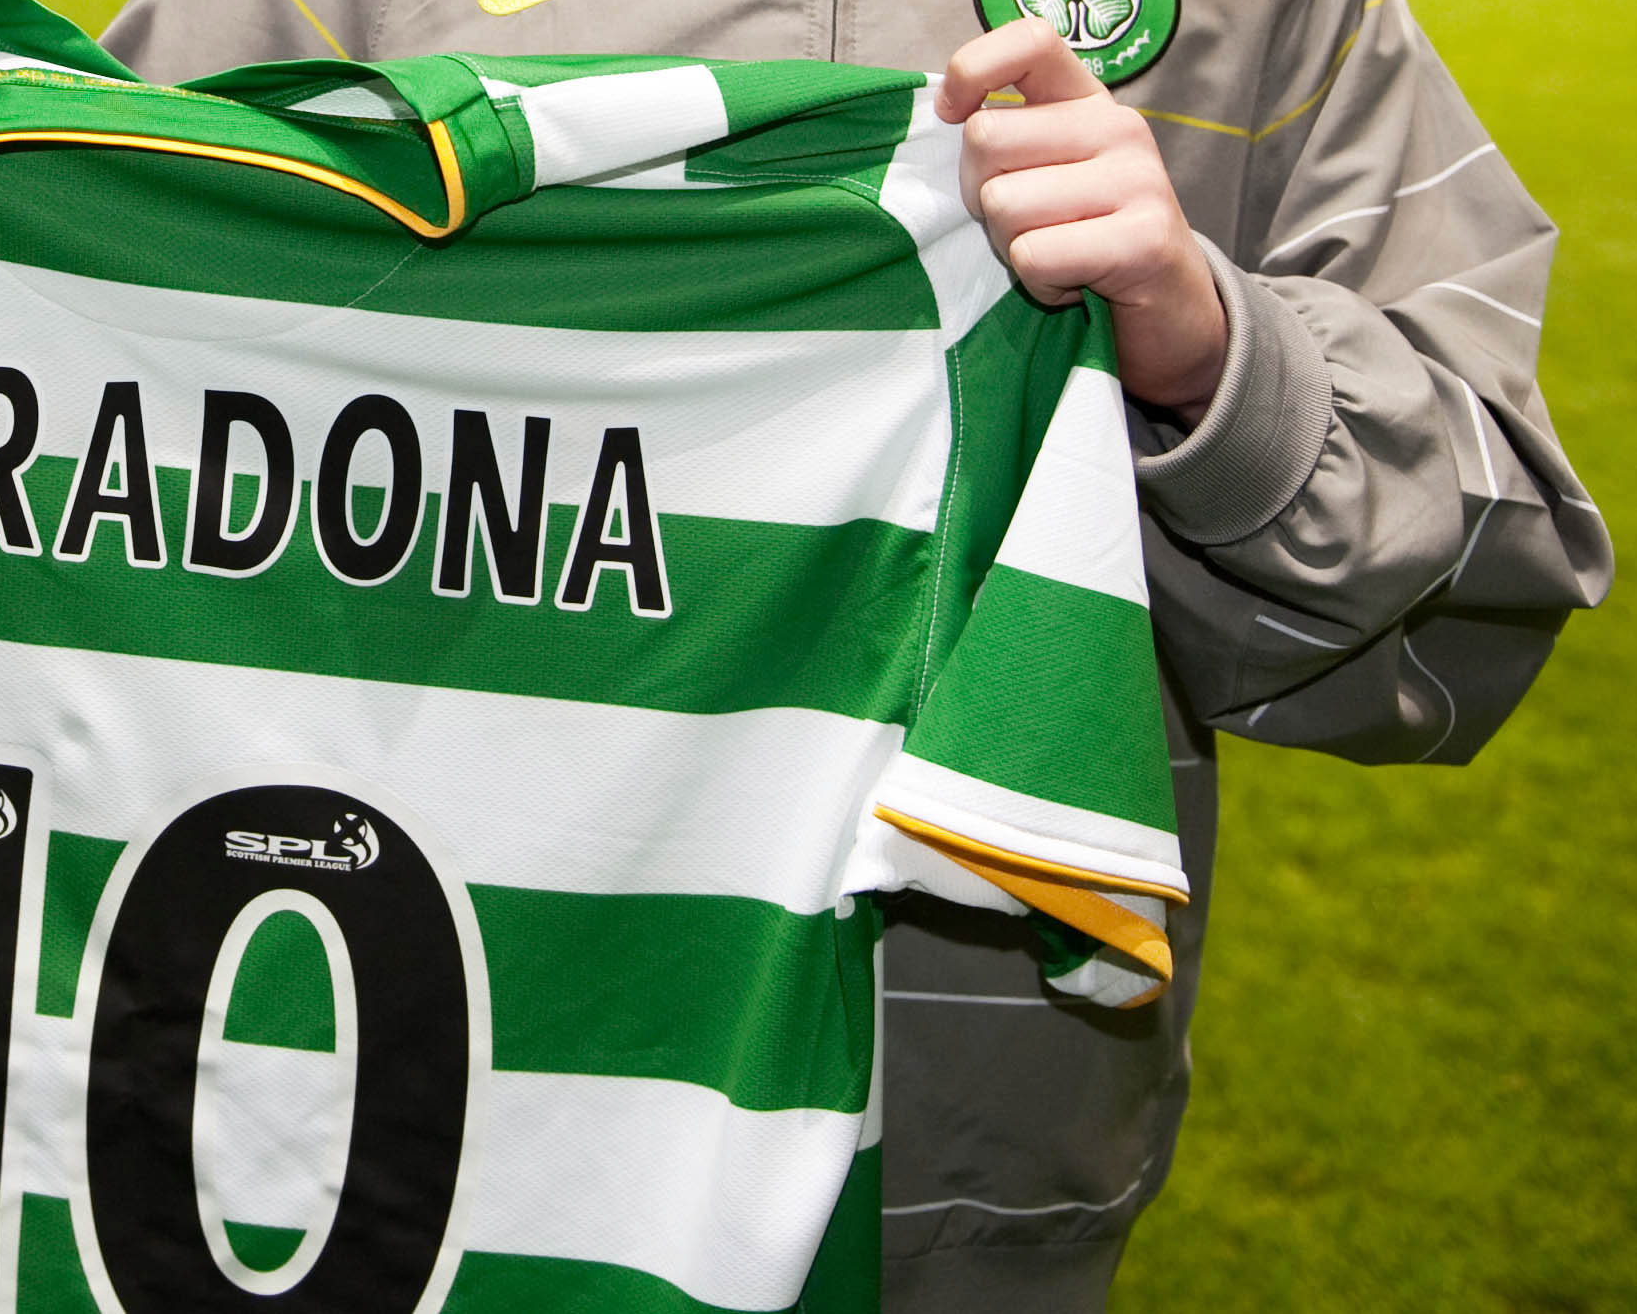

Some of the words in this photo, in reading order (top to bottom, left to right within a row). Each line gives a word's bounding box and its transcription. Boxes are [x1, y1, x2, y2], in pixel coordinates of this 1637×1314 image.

[224, 830, 352, 863] SPL
[225, 849, 271, 863] SCOTTISH
[272, 855, 313, 868] PREMIER
[314, 860, 352, 872] LEAGUE
